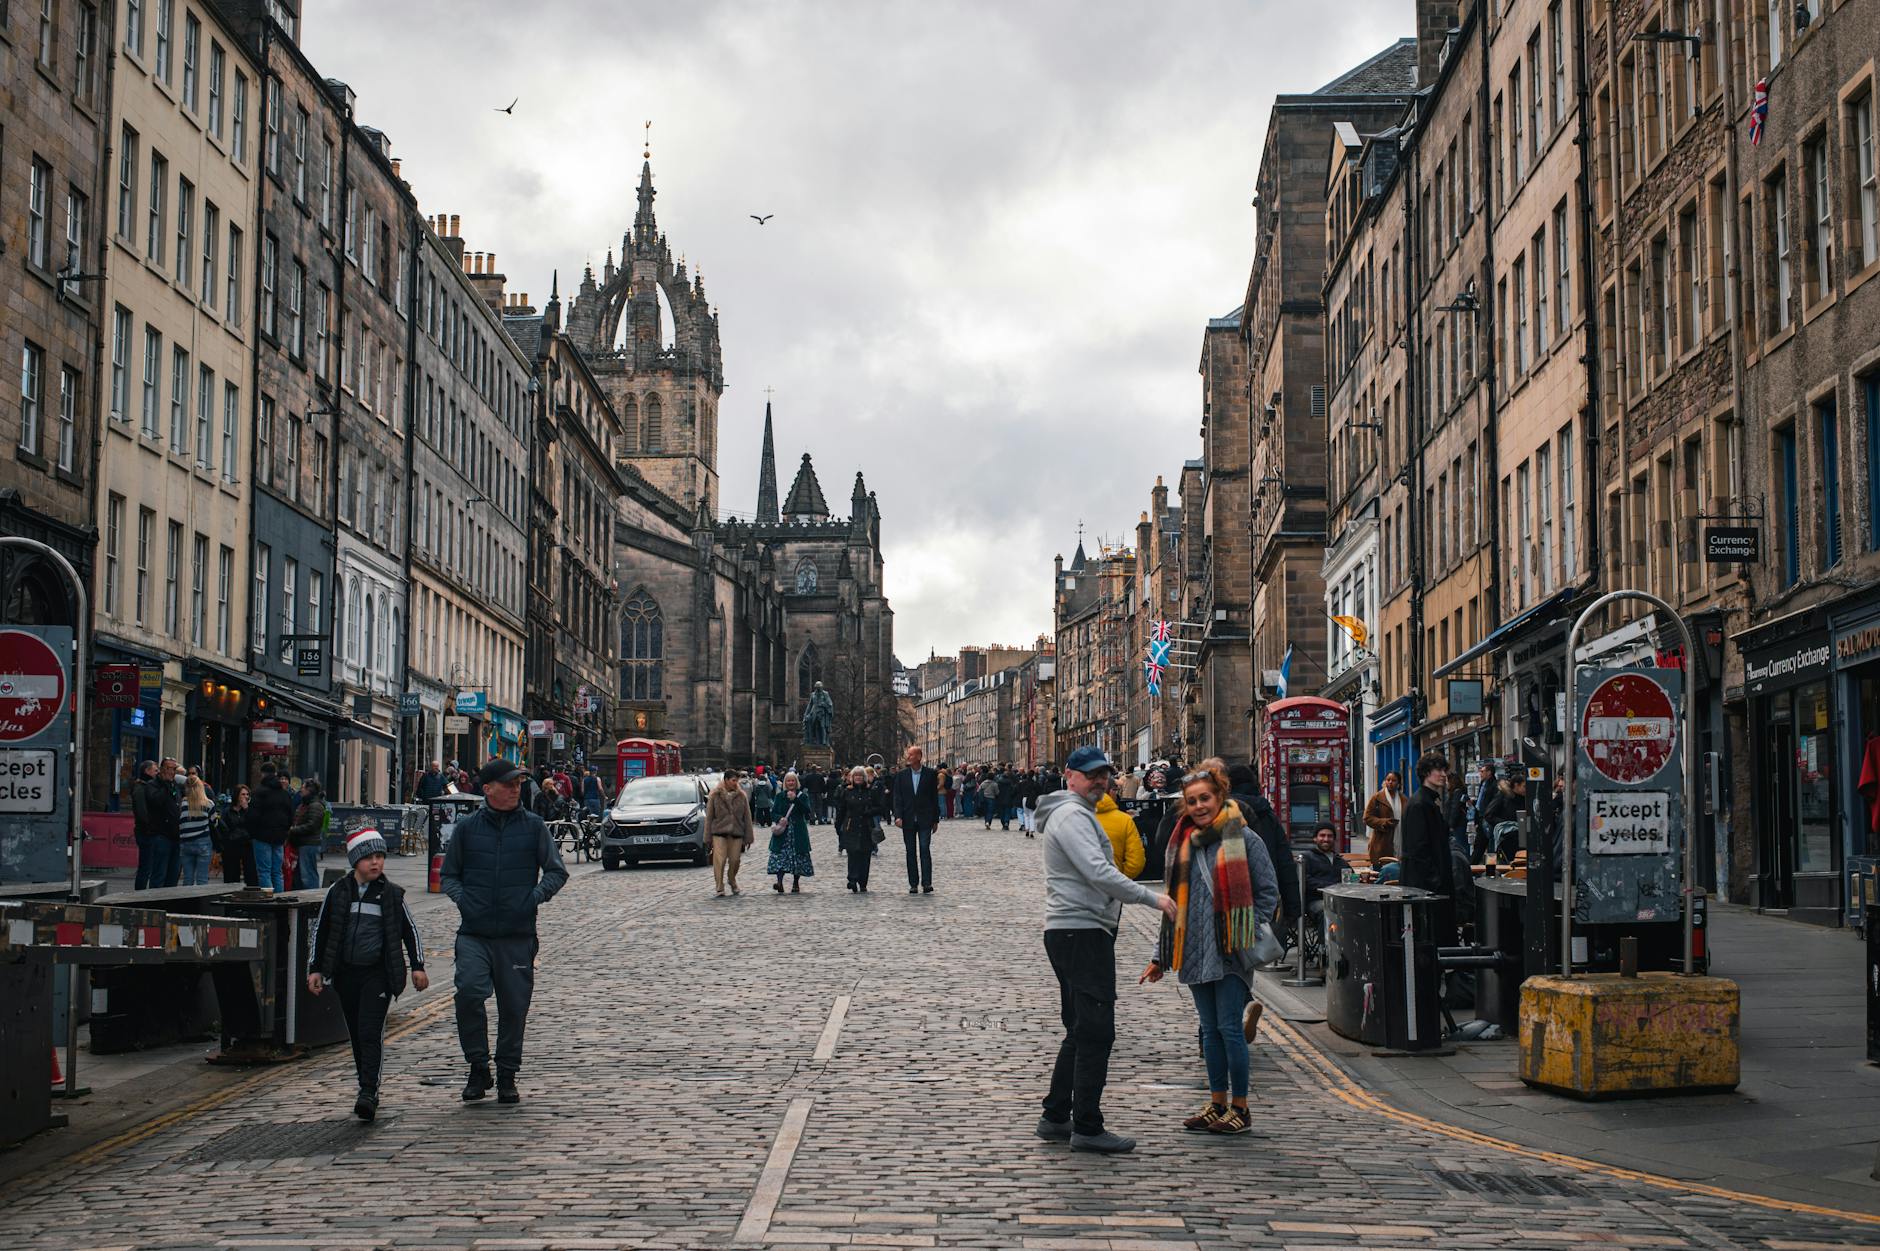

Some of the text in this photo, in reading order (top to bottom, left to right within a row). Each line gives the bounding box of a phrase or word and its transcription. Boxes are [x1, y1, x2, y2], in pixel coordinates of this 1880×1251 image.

[1710, 535, 1754, 545] Currency
[1709, 546, 1755, 556] Exchange
[302, 651, 320, 661] 156
[1768, 655, 1797, 677] Currency
[1797, 645, 1830, 668] Exchange
[1596, 800, 1661, 820] Except
